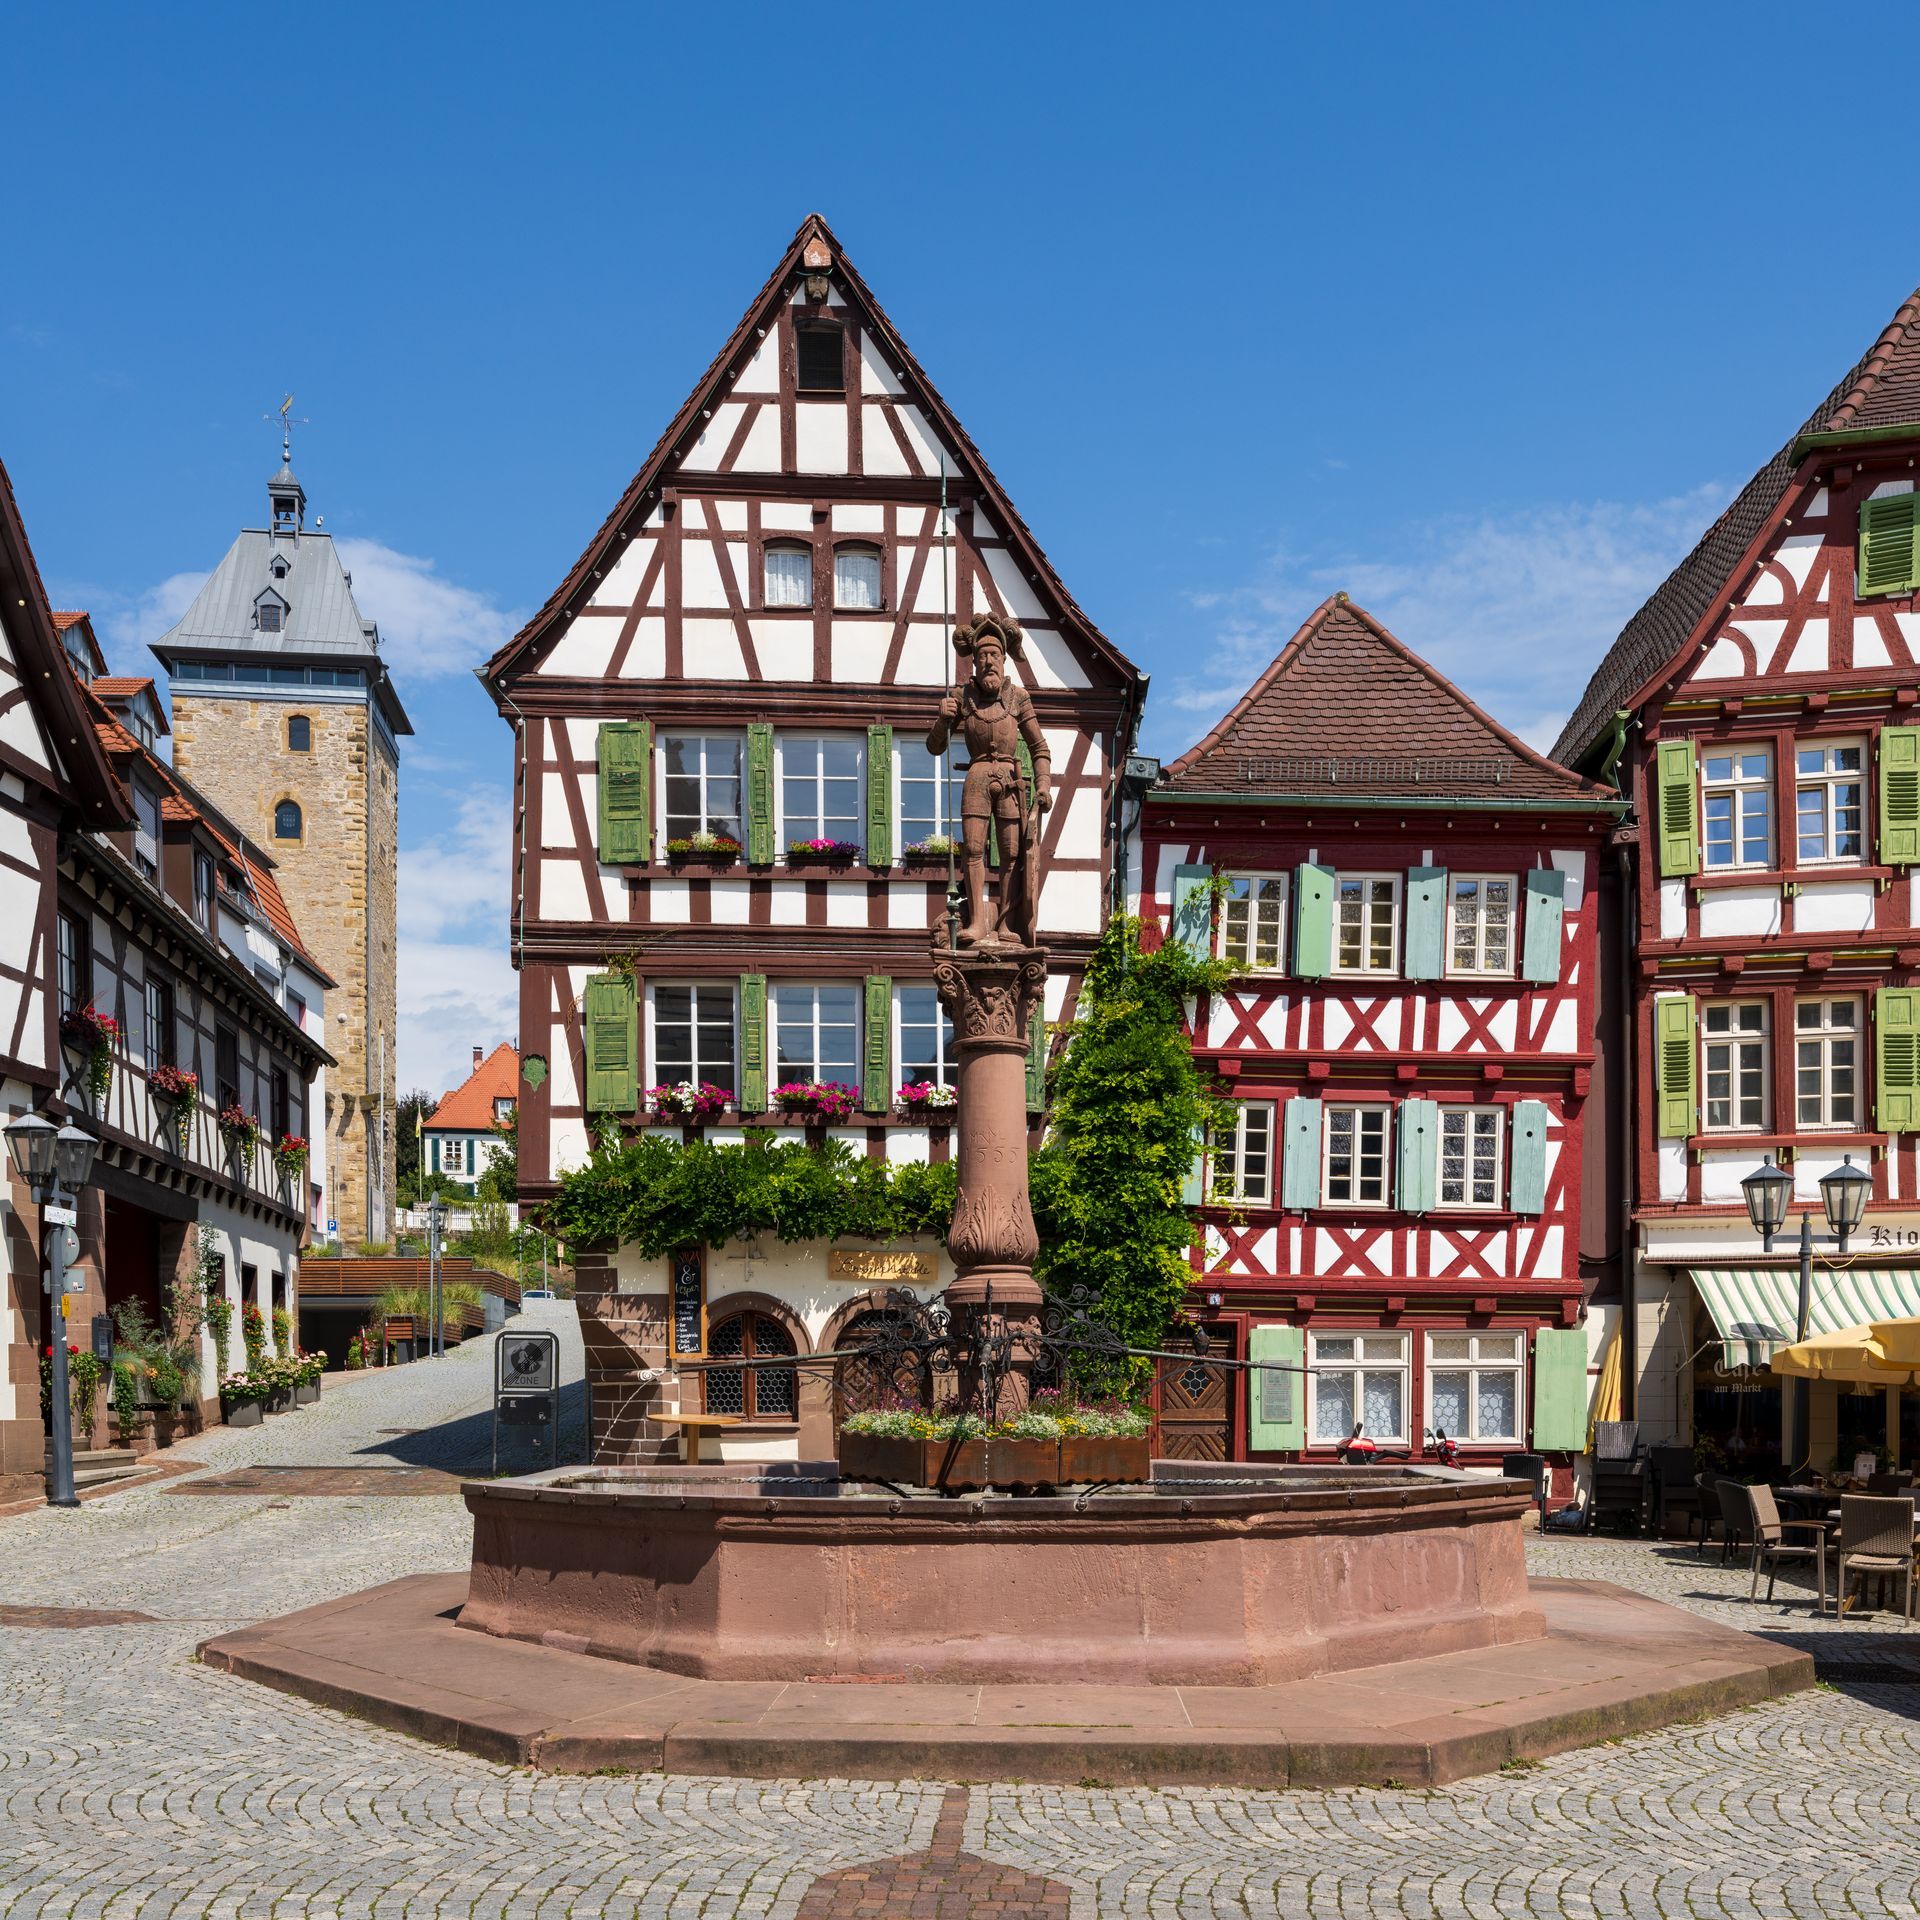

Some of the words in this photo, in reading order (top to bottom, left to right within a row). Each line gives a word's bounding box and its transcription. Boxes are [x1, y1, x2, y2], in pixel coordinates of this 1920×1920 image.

[515, 1376, 540, 1385] ZONE
[1714, 1385, 1728, 1393] am
[1731, 1384, 1762, 1393] Markt
